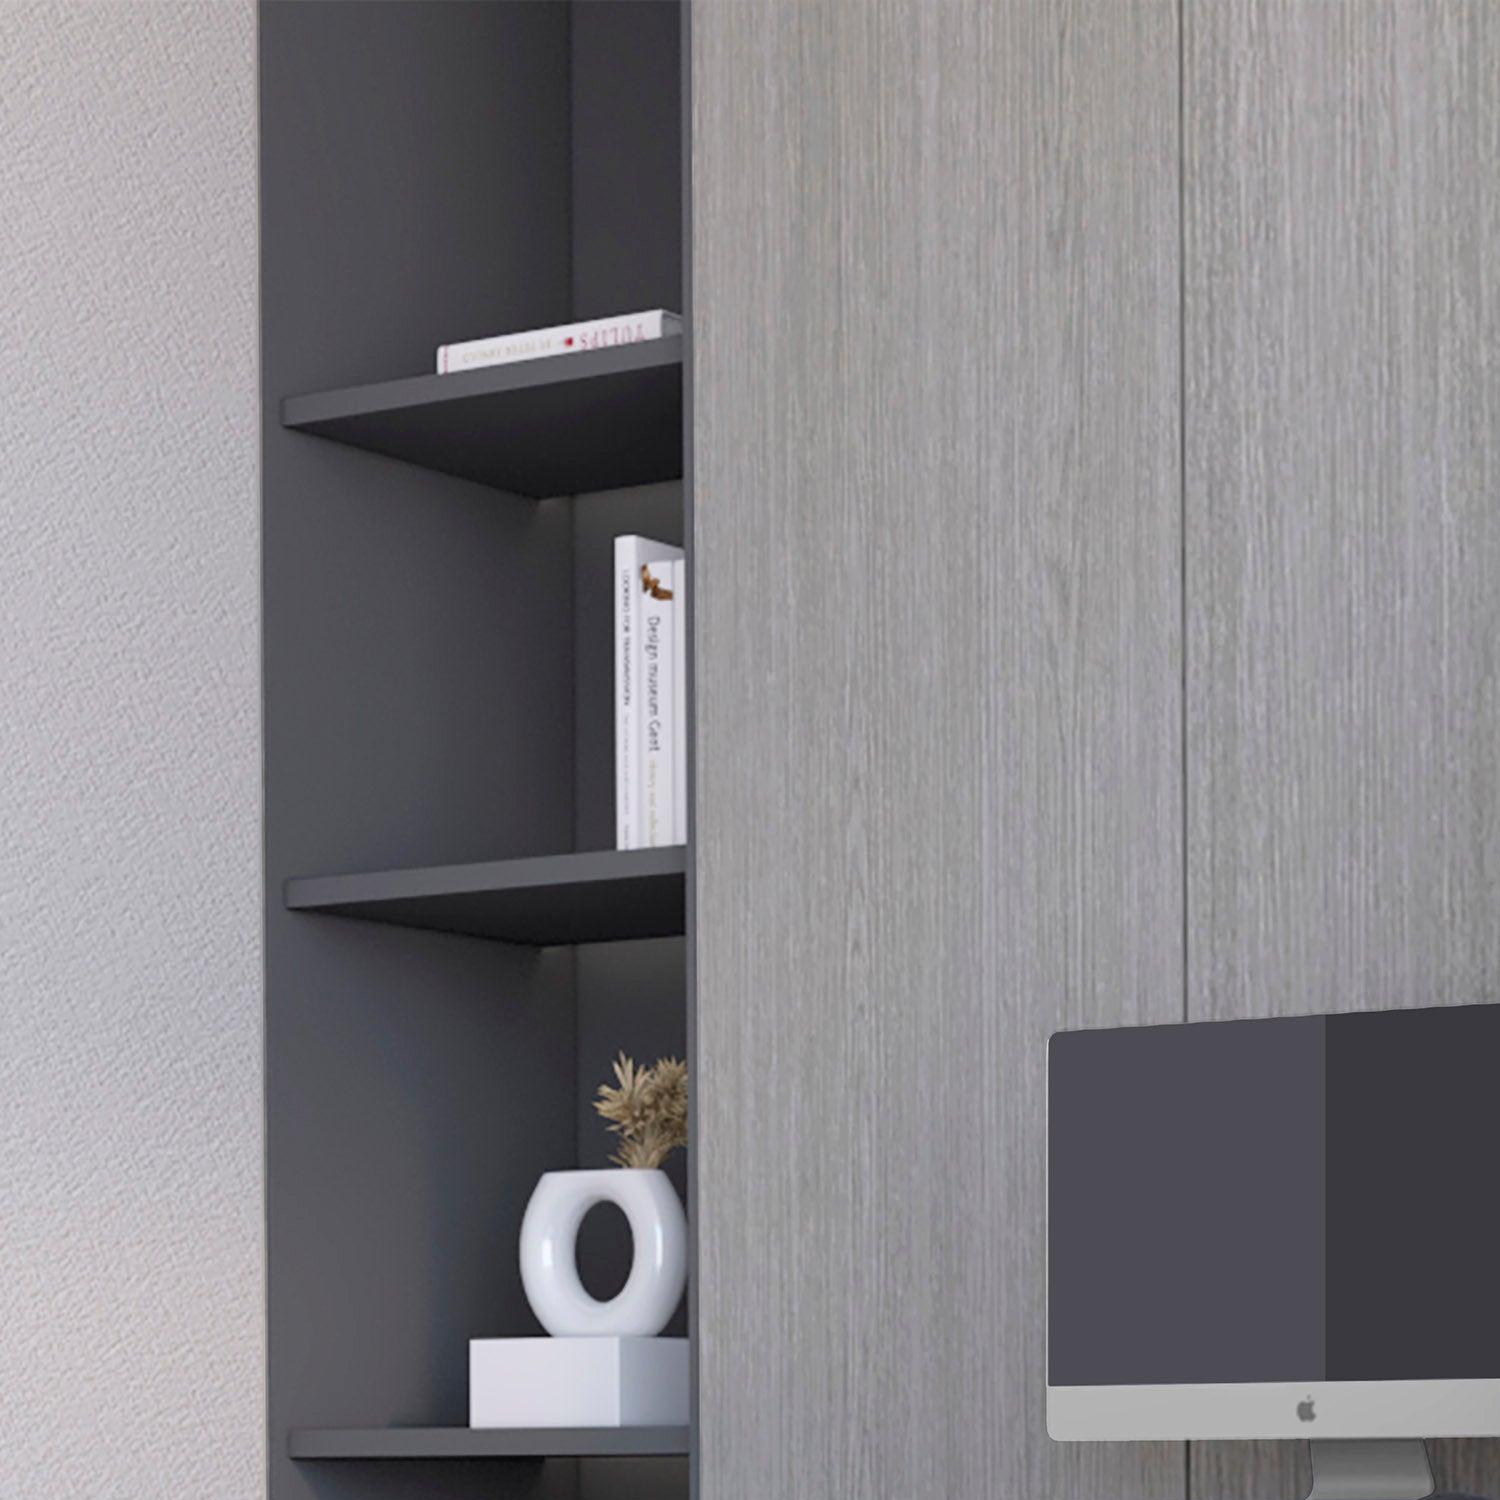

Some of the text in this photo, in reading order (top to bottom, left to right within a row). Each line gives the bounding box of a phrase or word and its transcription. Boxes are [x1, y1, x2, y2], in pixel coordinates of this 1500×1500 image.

[579, 323, 646, 350] TULIPS
[644, 615, 661, 661] Design
[647, 663, 659, 717] museum
[647, 719, 661, 752] Gent
